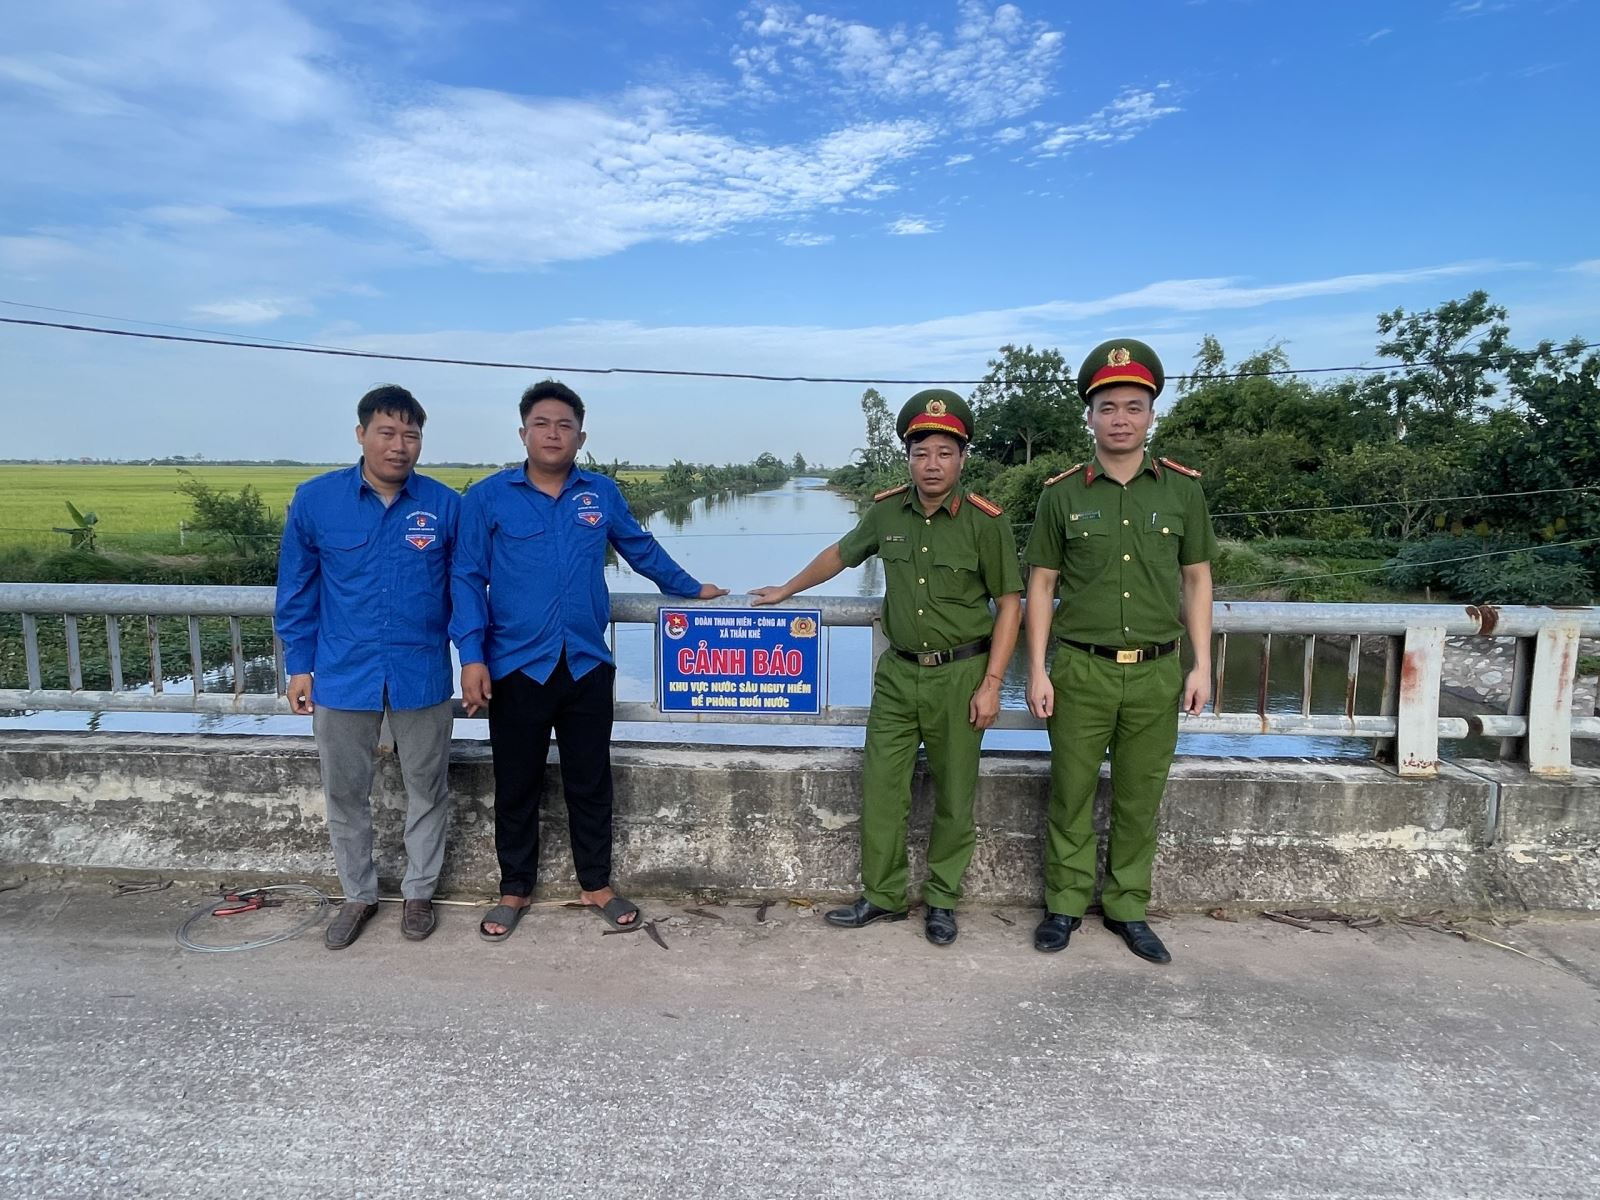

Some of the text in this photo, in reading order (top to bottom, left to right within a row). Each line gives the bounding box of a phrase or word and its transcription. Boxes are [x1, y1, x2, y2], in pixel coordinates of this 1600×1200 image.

[714, 617, 735, 626] THANH
[736, 616, 752, 626] NIÊN
[757, 616, 776, 627] CÔNG
[776, 618, 786, 627] AN
[678, 640, 803, 676] CẢNH BÁO
[669, 681, 689, 692] KHU
[690, 681, 709, 694] VỰC
[711, 680, 737, 692] NƯỚC
[738, 680, 758, 693] SÂU
[759, 683, 786, 693] NGUY
[706, 694, 738, 707] PHÒNG
[763, 696, 790, 708] NƯỚC
